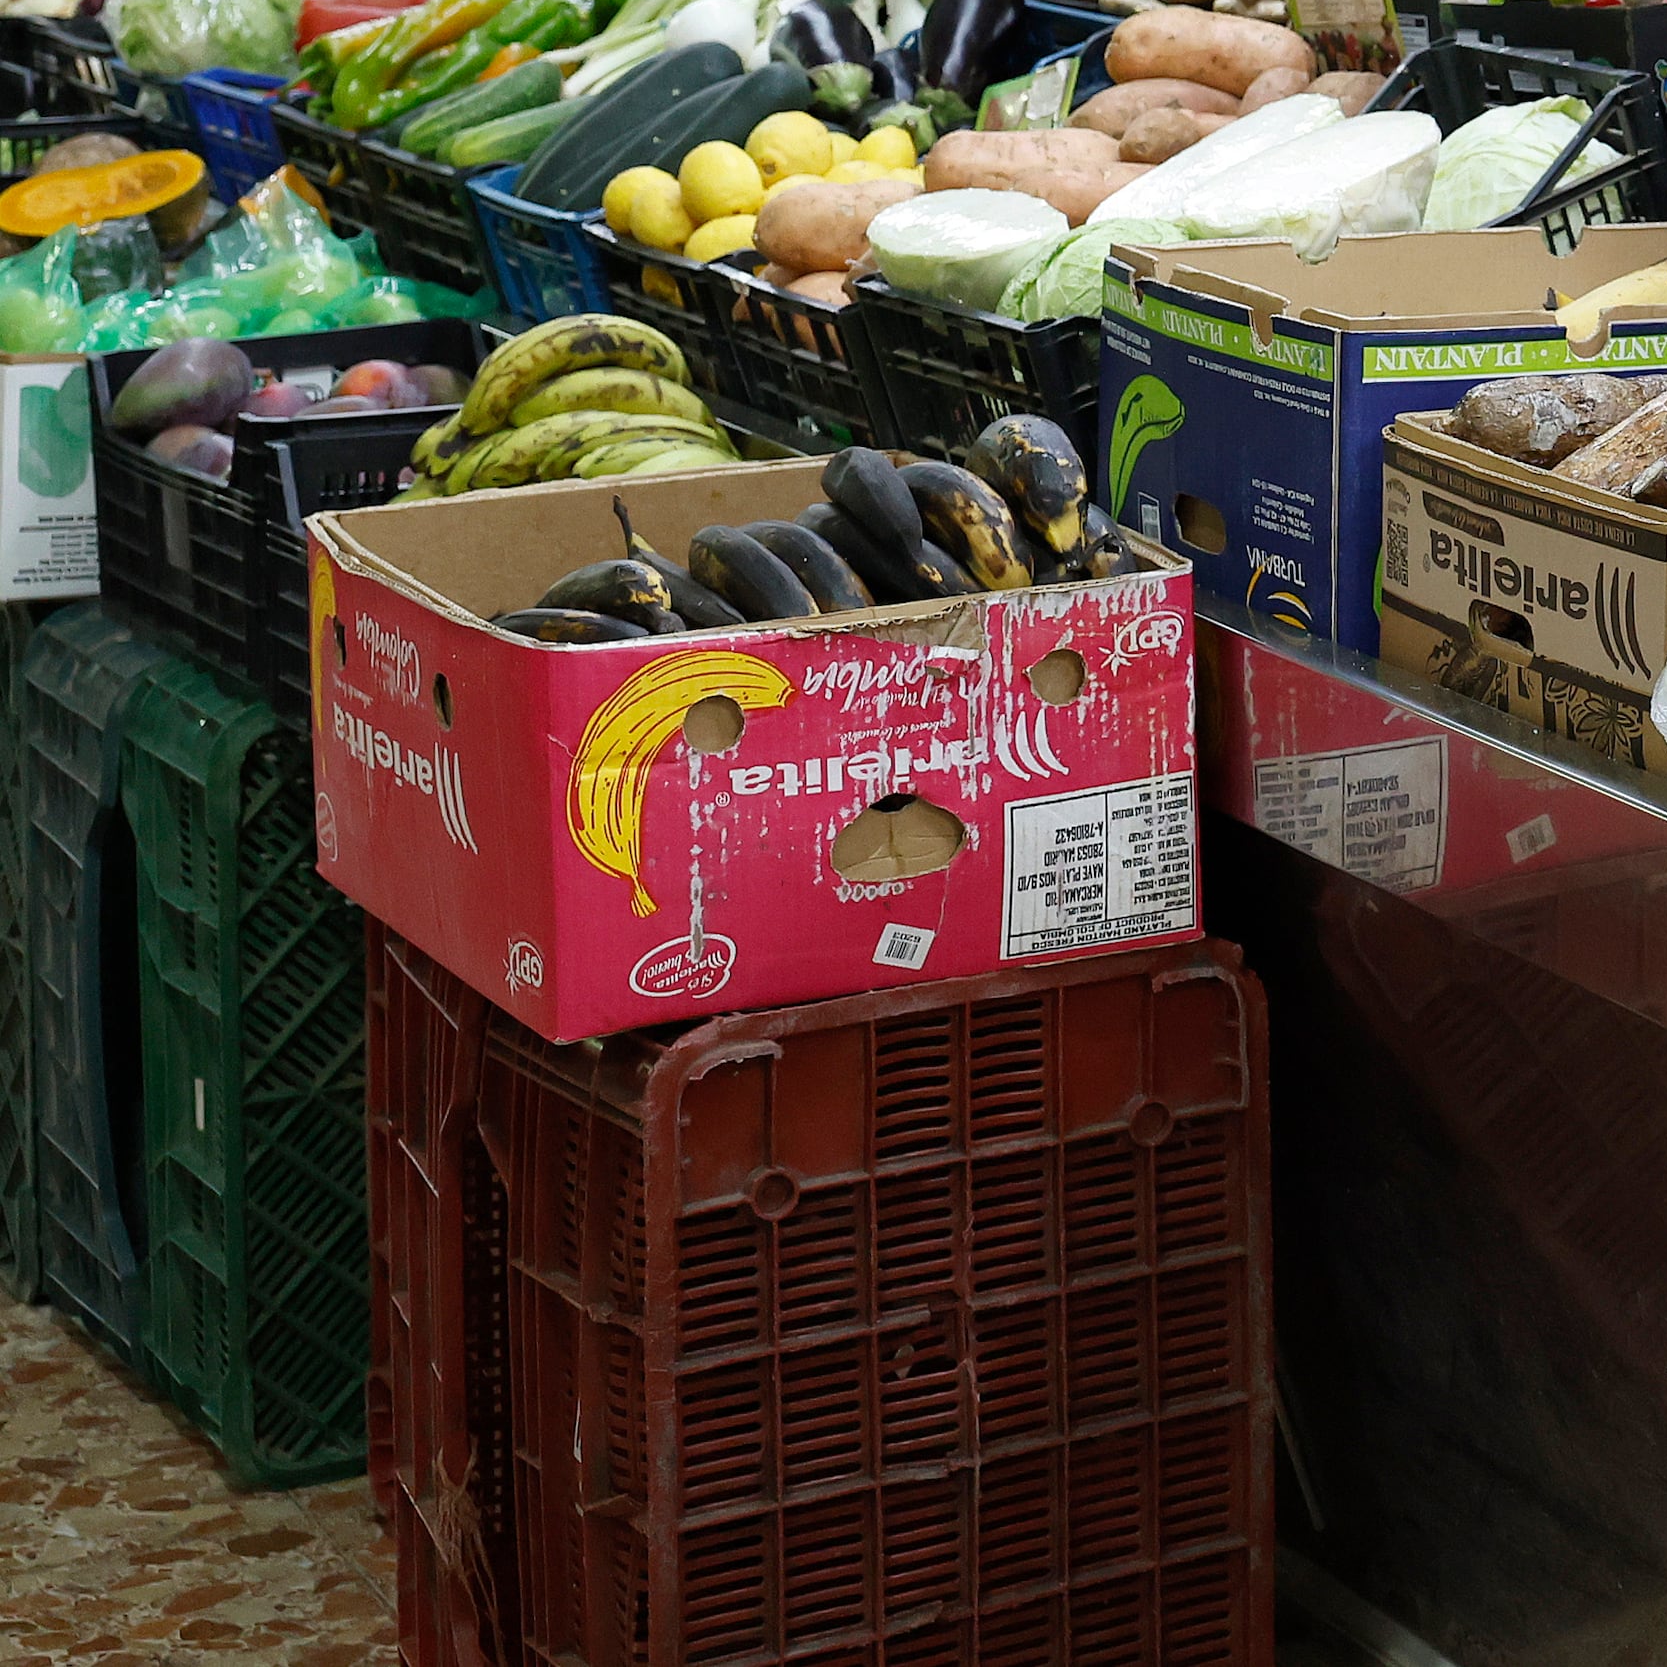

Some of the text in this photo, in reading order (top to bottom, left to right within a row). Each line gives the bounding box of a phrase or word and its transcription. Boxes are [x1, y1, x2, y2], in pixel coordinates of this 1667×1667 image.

[1162, 309, 1224, 347] PLANTAIN
[1374, 343, 1525, 371] PLANTAIN
[1282, 382, 1295, 395] DOLE
[1246, 545, 1306, 587] TURBANA
[354, 610, 420, 699] Colombia
[1077, 842, 1103, 858] 28053
[1040, 914, 1165, 940] PRODUCT OF COLOMBIA
[1032, 936, 1074, 949] FRESCO
